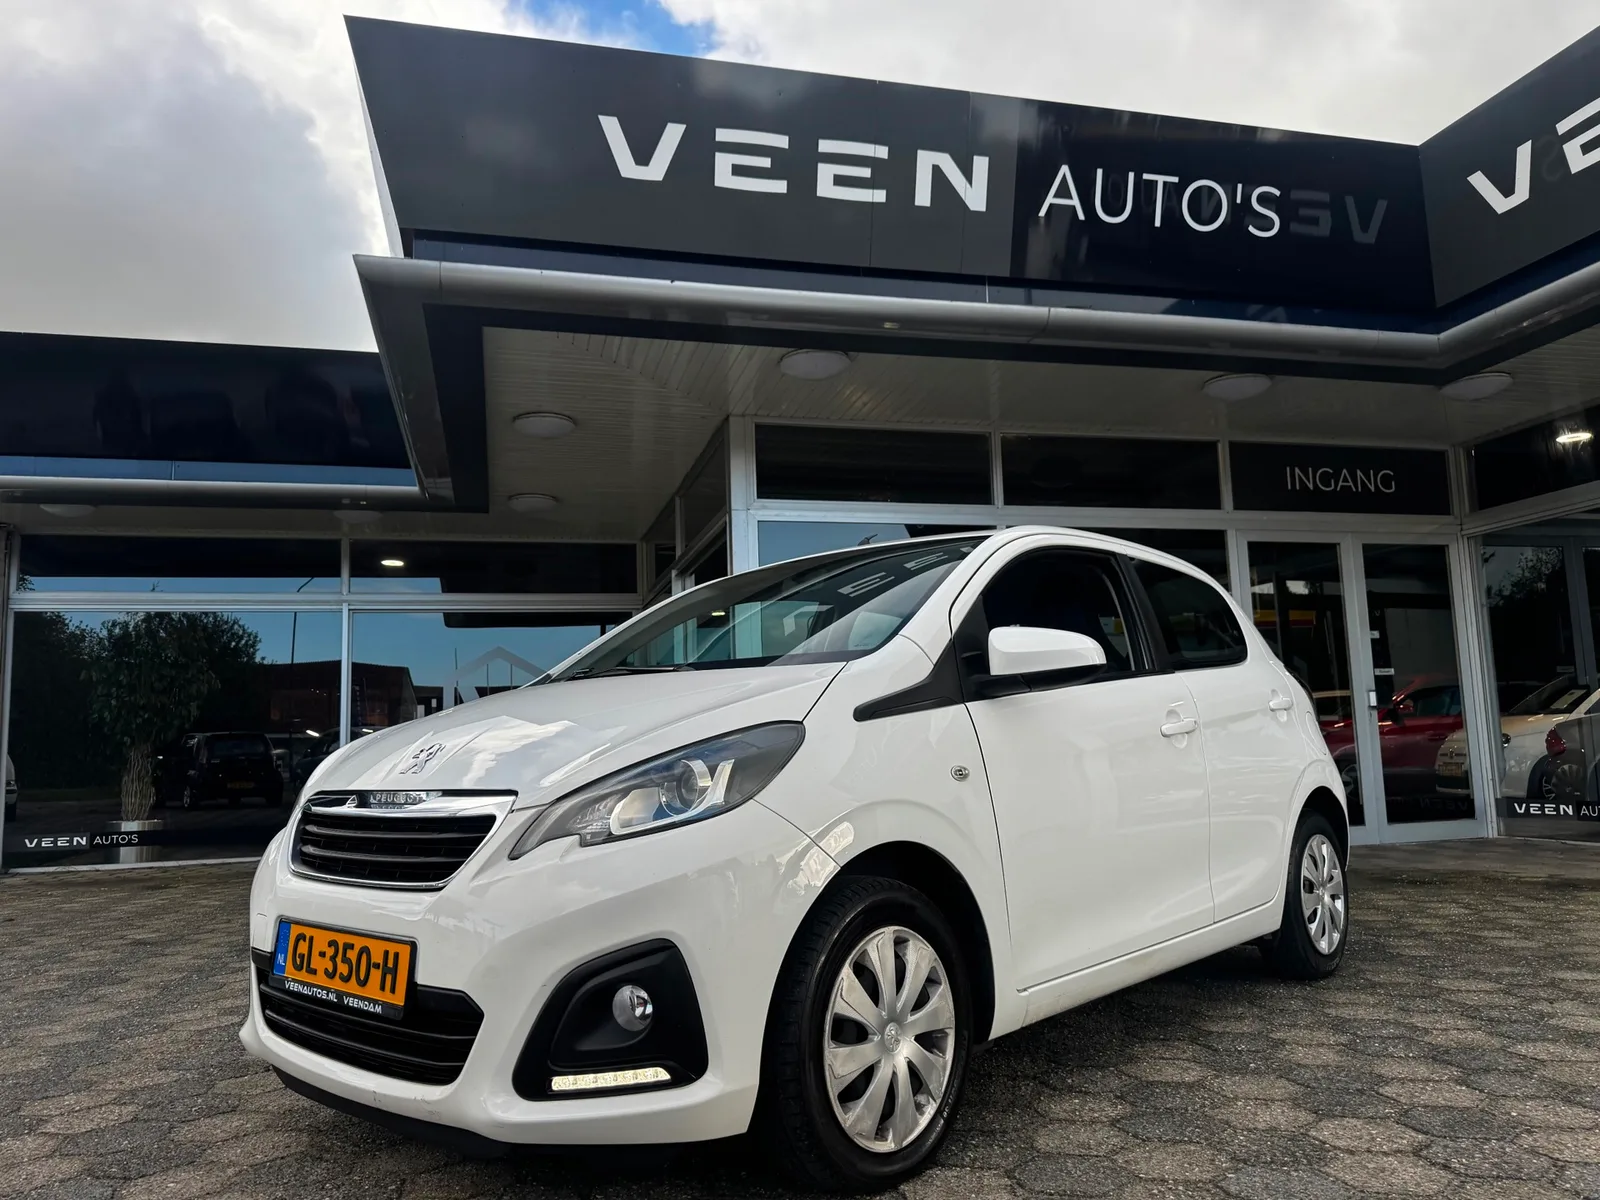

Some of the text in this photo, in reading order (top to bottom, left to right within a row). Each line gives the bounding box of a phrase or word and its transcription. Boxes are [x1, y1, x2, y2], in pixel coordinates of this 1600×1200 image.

[598, 114, 1281, 238] VEEN AUTO'S
[1286, 466, 1396, 493] INGANG
[1514, 803, 1600, 817] VEEN AU
[25, 834, 139, 848] VEEN AUTO'S
[277, 953, 286, 966] NL
[291, 932, 400, 994] GL-350-H
[284, 980, 383, 1014] VEENAUTOS.NL VEENDAM
